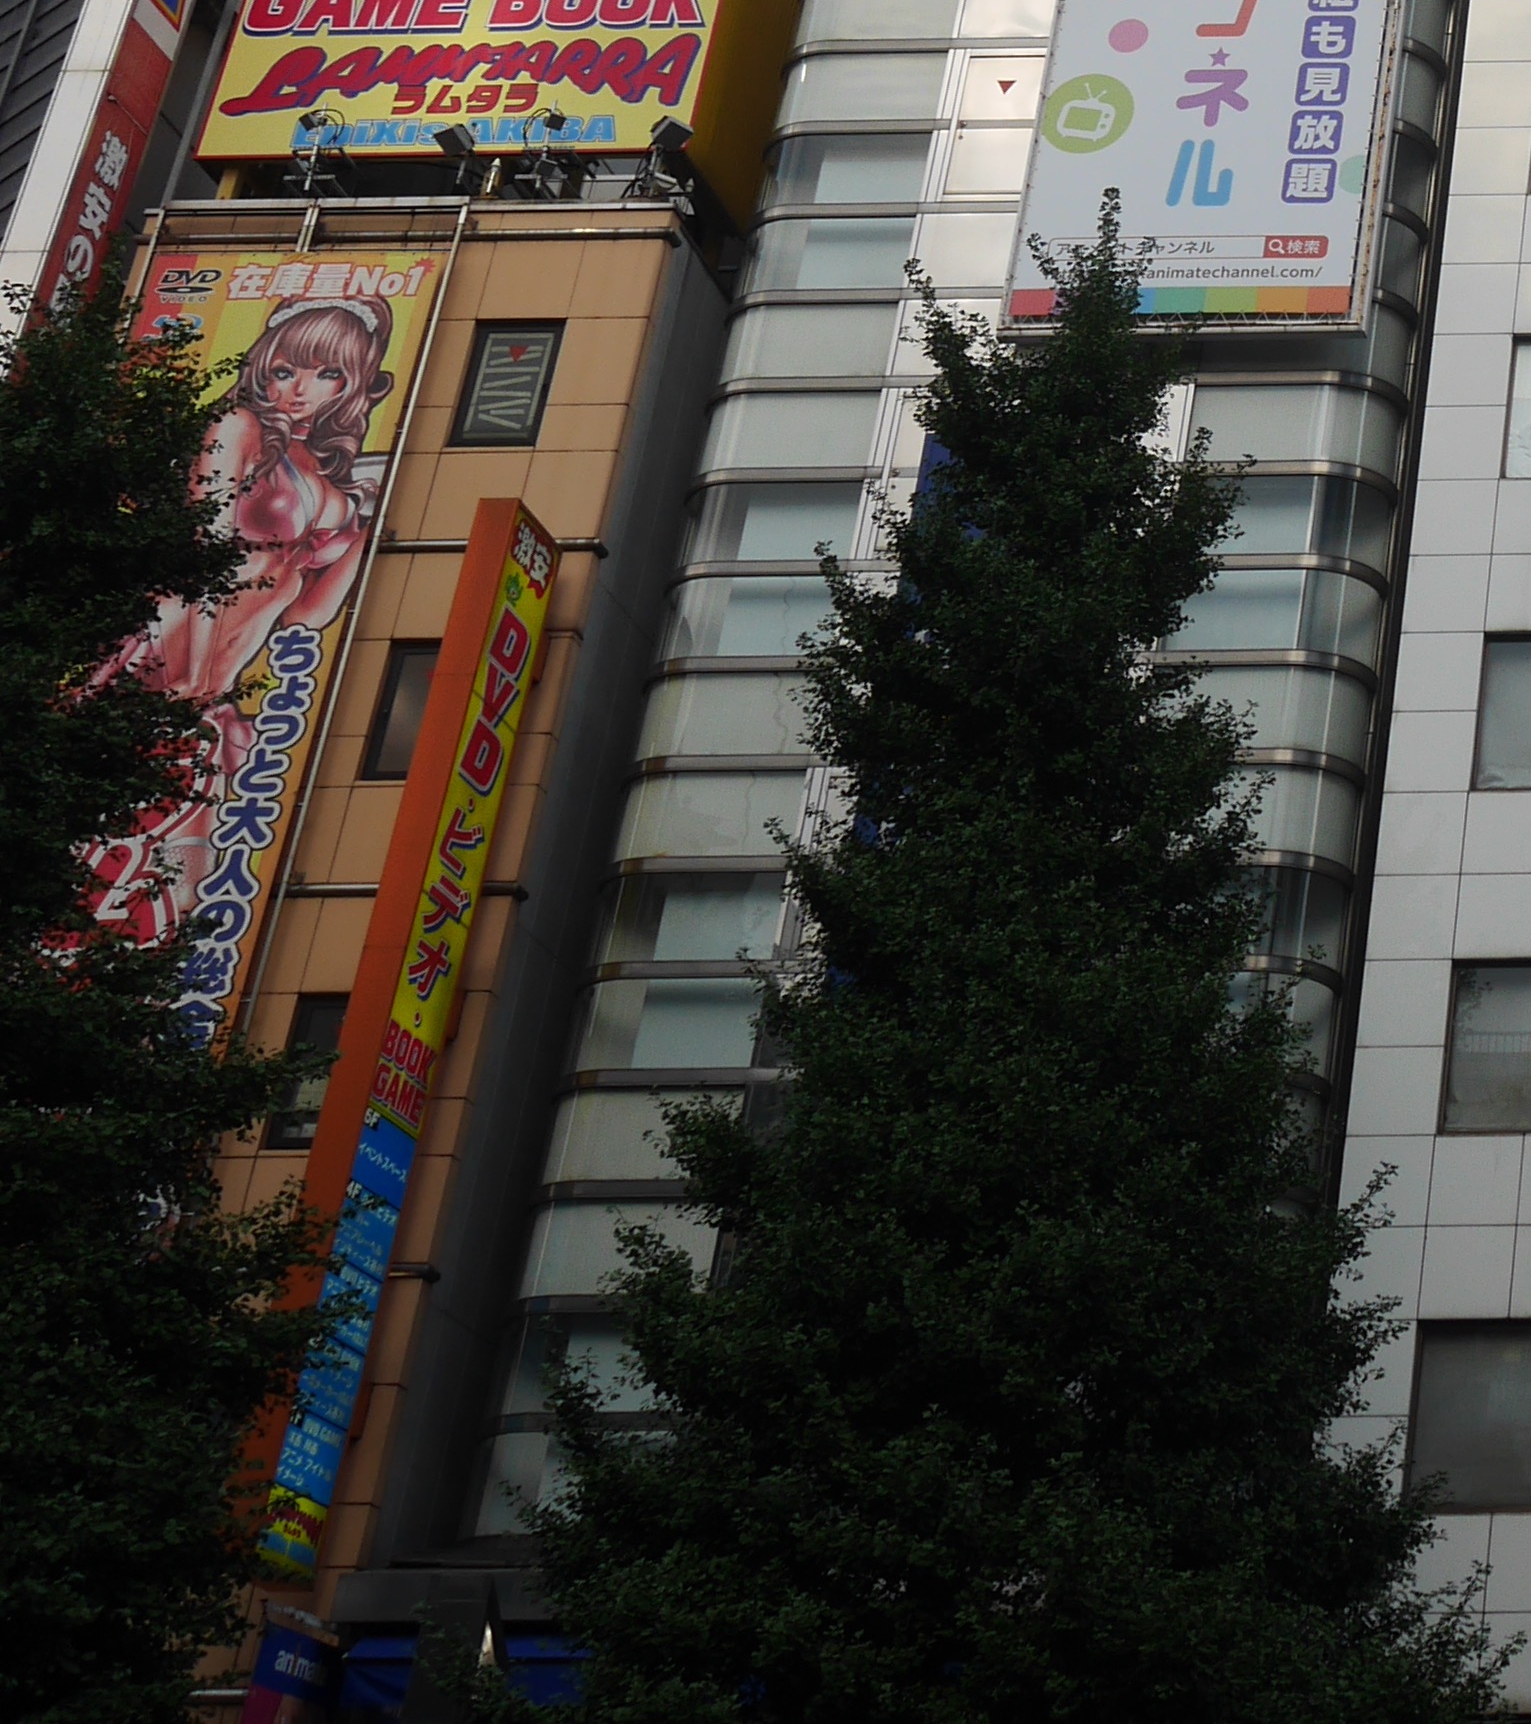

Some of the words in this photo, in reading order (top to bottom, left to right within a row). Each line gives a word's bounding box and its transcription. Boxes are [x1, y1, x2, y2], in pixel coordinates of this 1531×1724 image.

[391, 82, 541, 116] ラムタラ
[471, 116, 617, 145] AKIBA
[1056, 238, 1215, 258] アニメトチャンネル
[1286, 240, 1320, 254] 検索
[161, 269, 222, 285] DVD
[159, 296, 208, 304] VIDEO
[511, 521, 552, 585] 激安
[381, 1017, 436, 1086] BOOK
[369, 1060, 426, 1132] GAME
